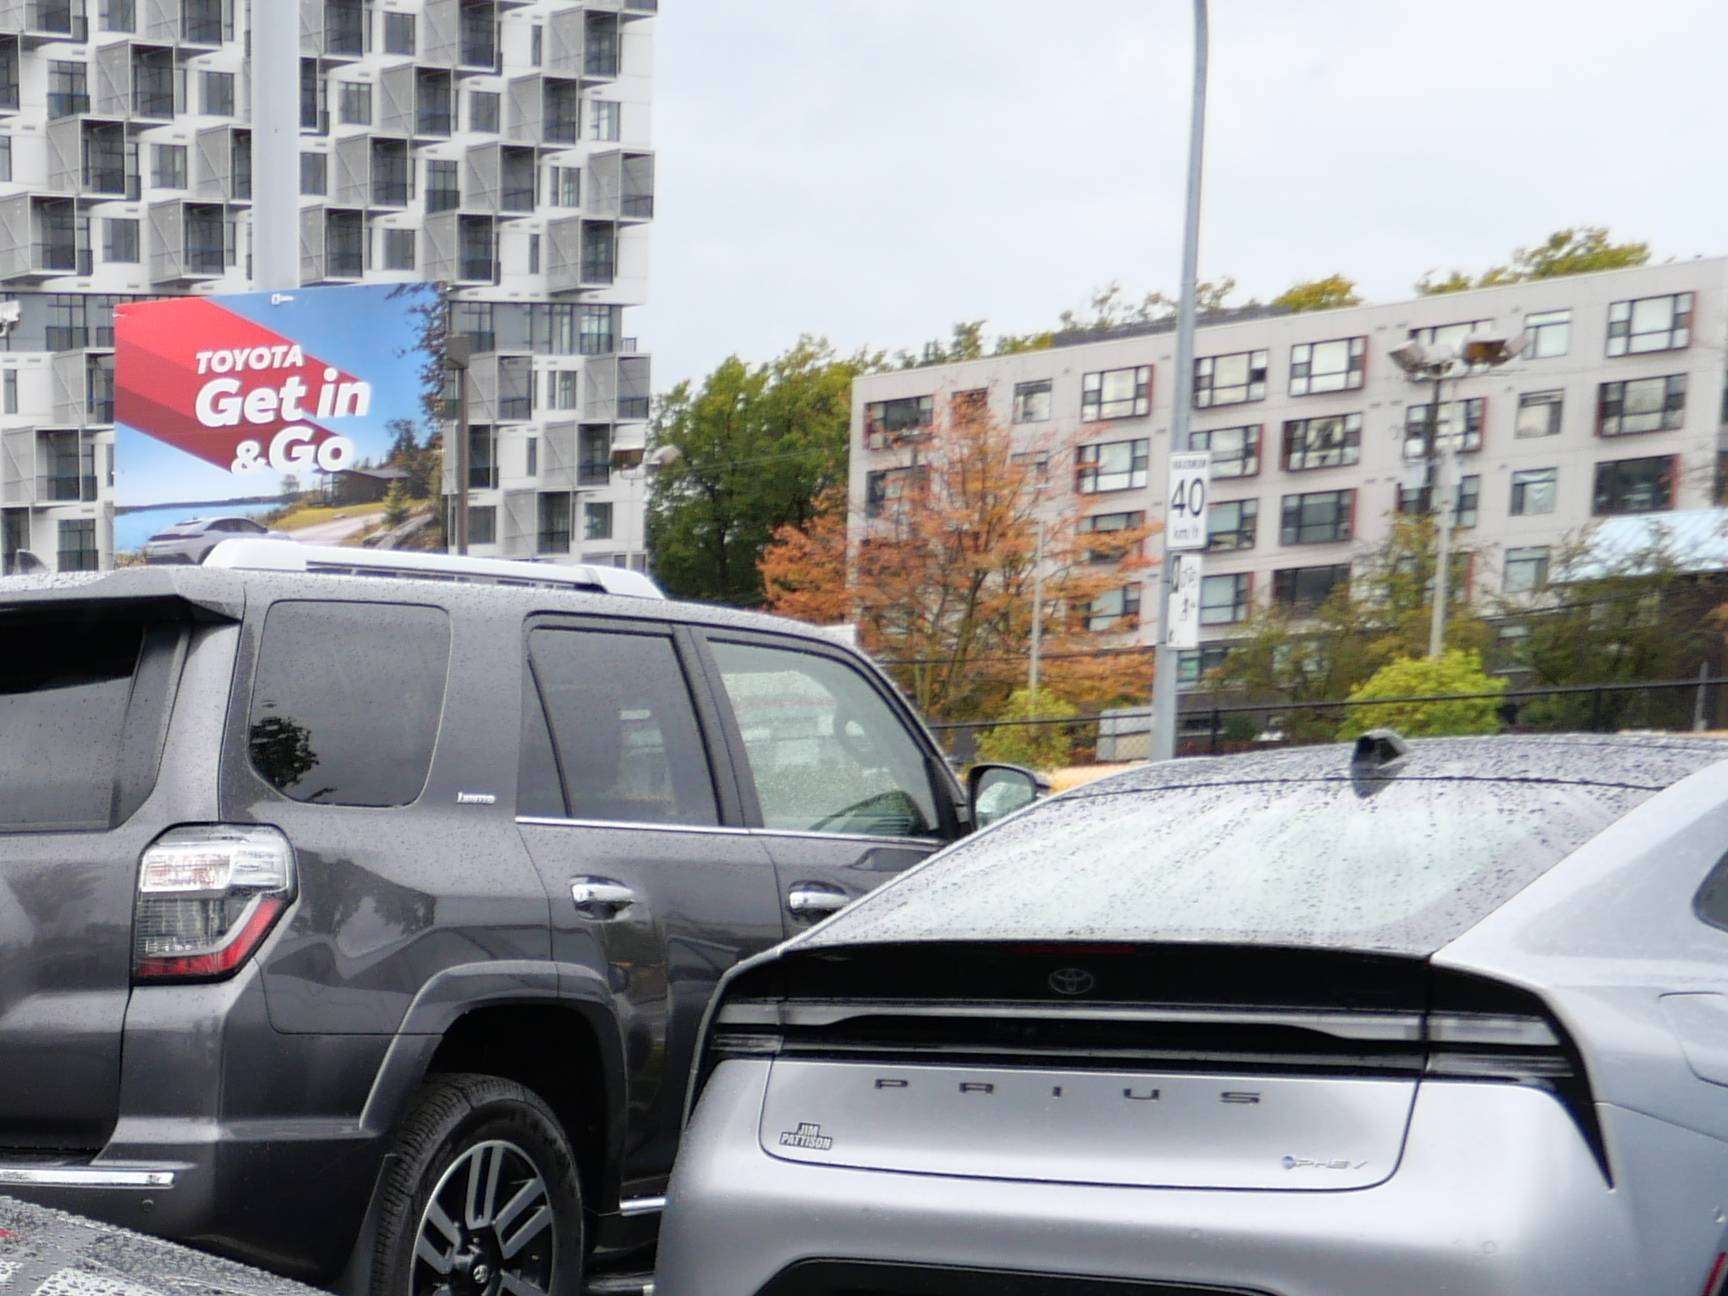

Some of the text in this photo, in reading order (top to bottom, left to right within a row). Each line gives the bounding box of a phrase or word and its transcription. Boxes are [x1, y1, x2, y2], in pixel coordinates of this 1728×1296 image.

[195, 345, 304, 374] TOYOTA
[195, 367, 372, 428] Get in
[1171, 478, 1204, 518] 40
[780, 1133, 831, 1149] PATTISON
[798, 1124, 819, 1137] JIM
